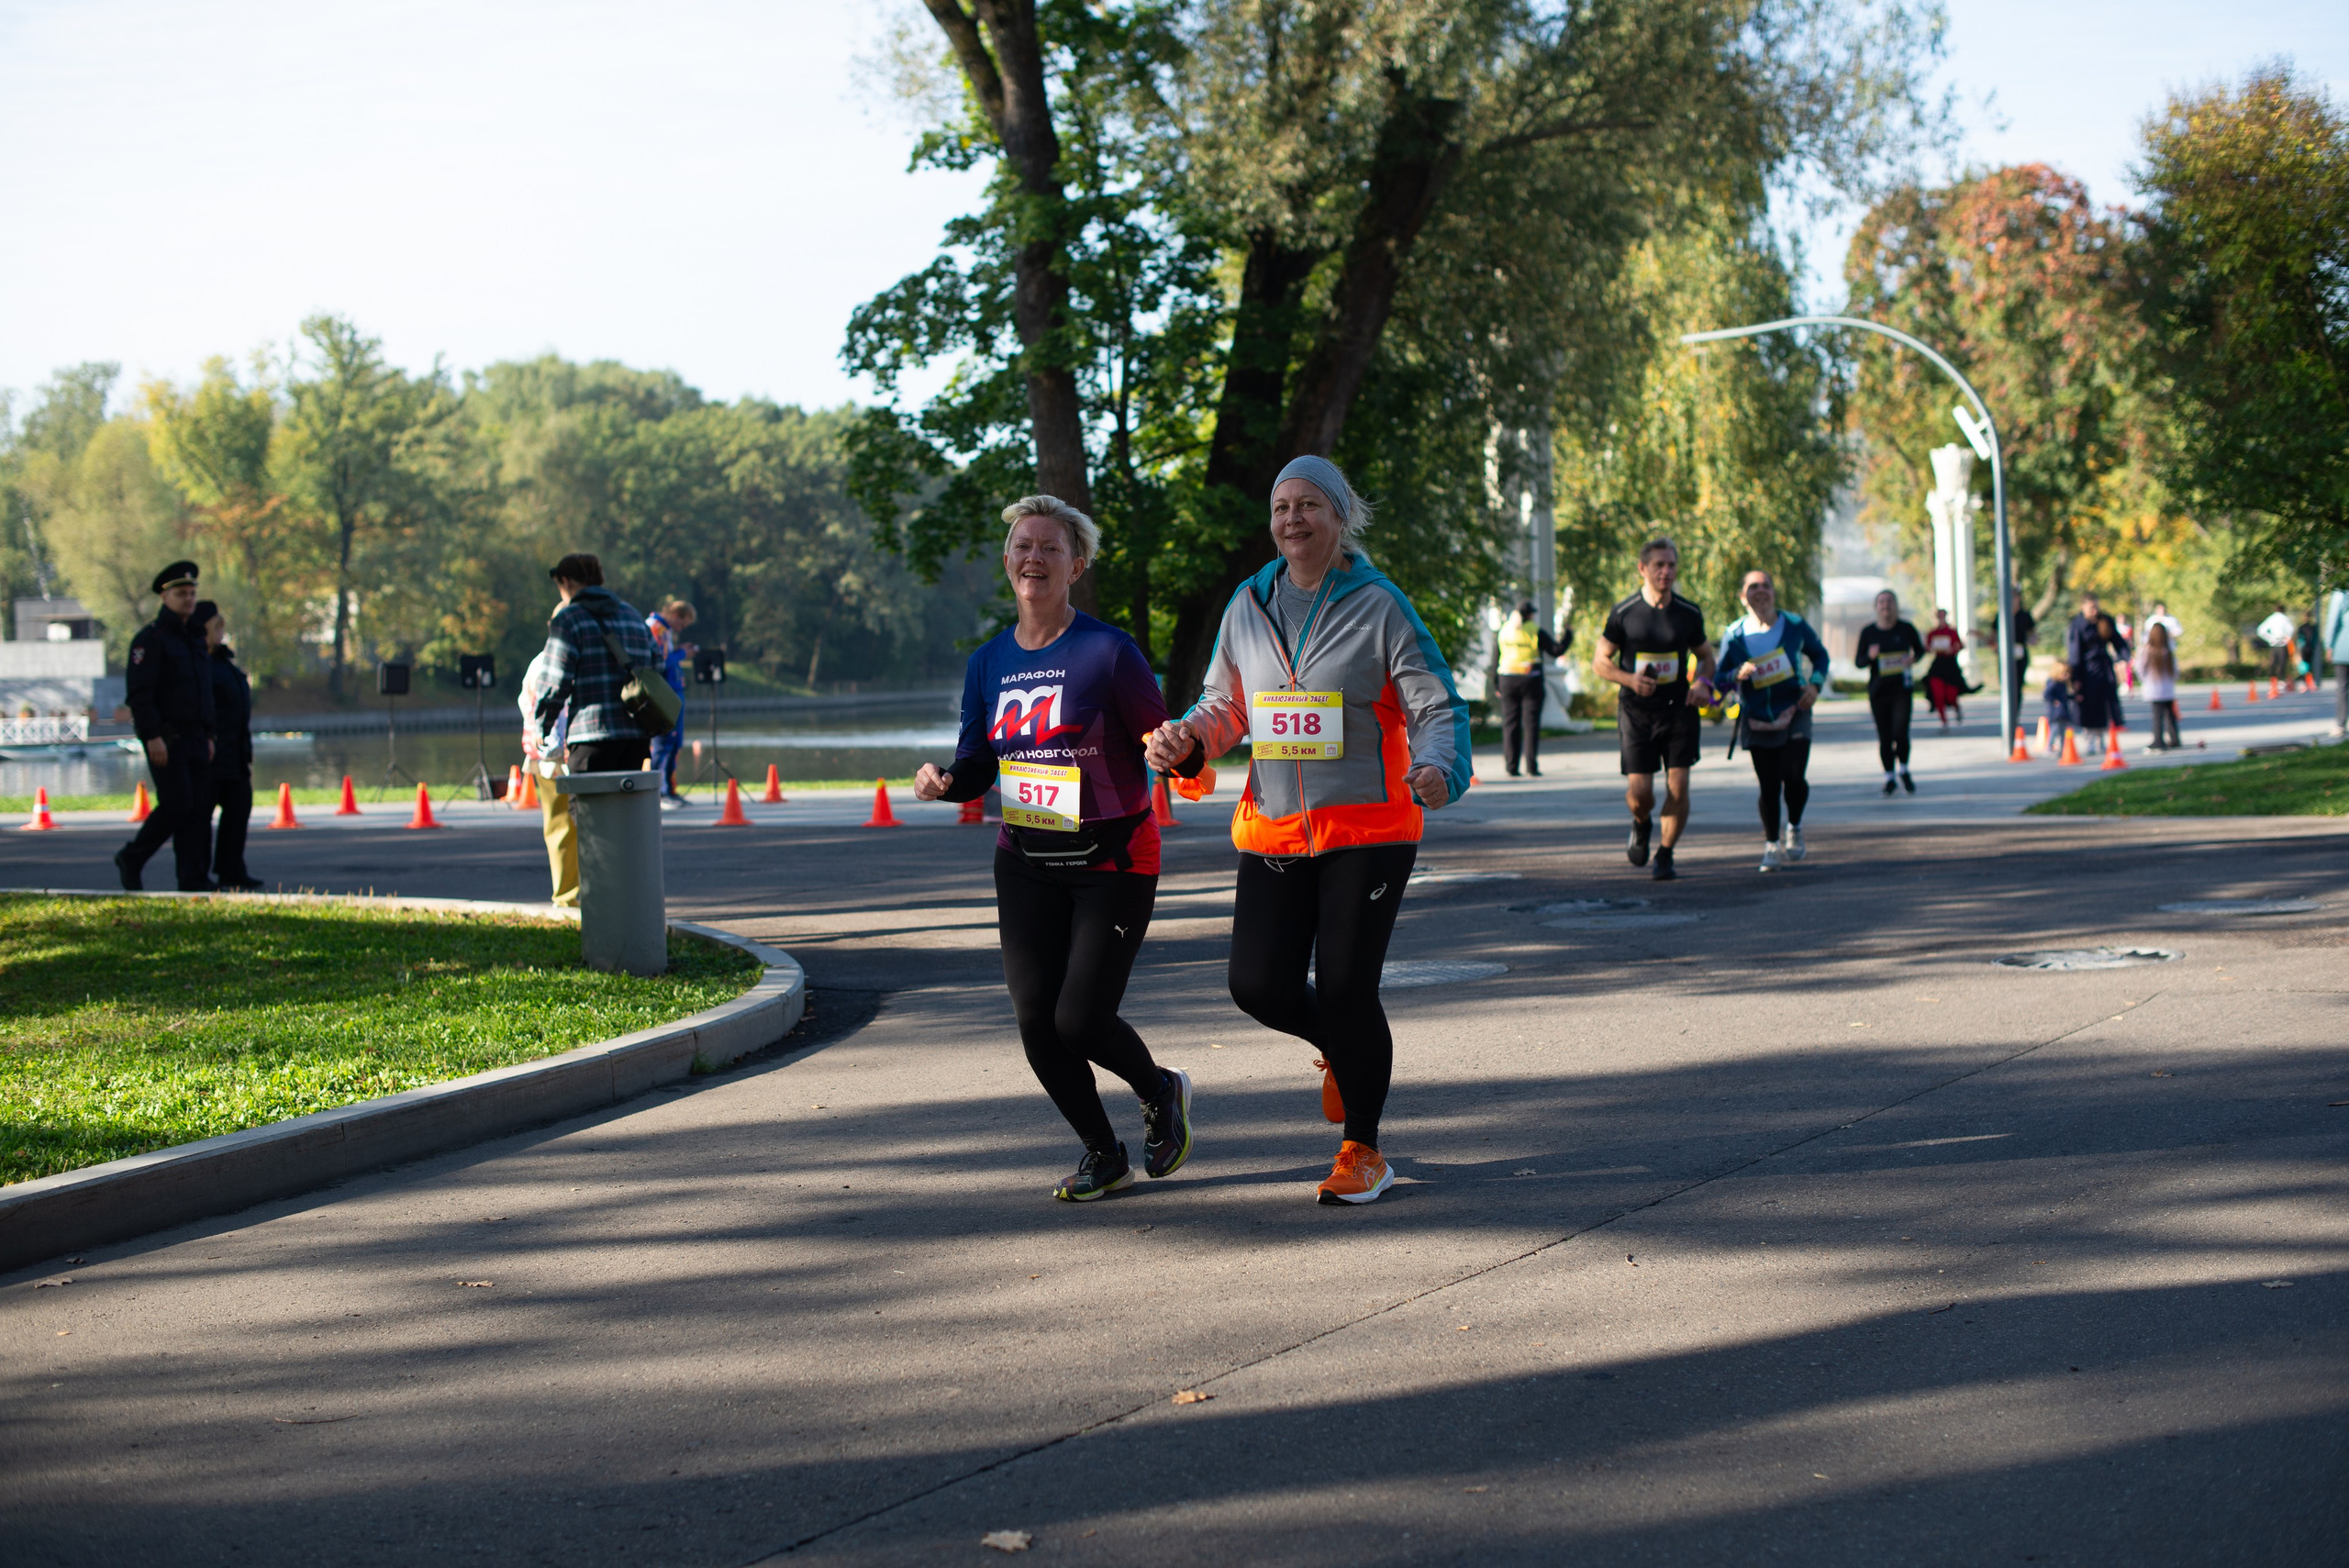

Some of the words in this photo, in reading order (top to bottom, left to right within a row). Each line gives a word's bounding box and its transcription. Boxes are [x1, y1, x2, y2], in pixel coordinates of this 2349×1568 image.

[1001, 670, 1065, 684] МАРАФОН
[1263, 695, 1308, 703] ИНКЛЮЗИВНЫЙ
[1272, 712, 1321, 735] 518
[1026, 747, 1098, 759] НОВГОРОД
[1281, 745, 1298, 756] 5,5
[1019, 782, 1060, 806] 517
[1026, 814, 1041, 825] 5,5
